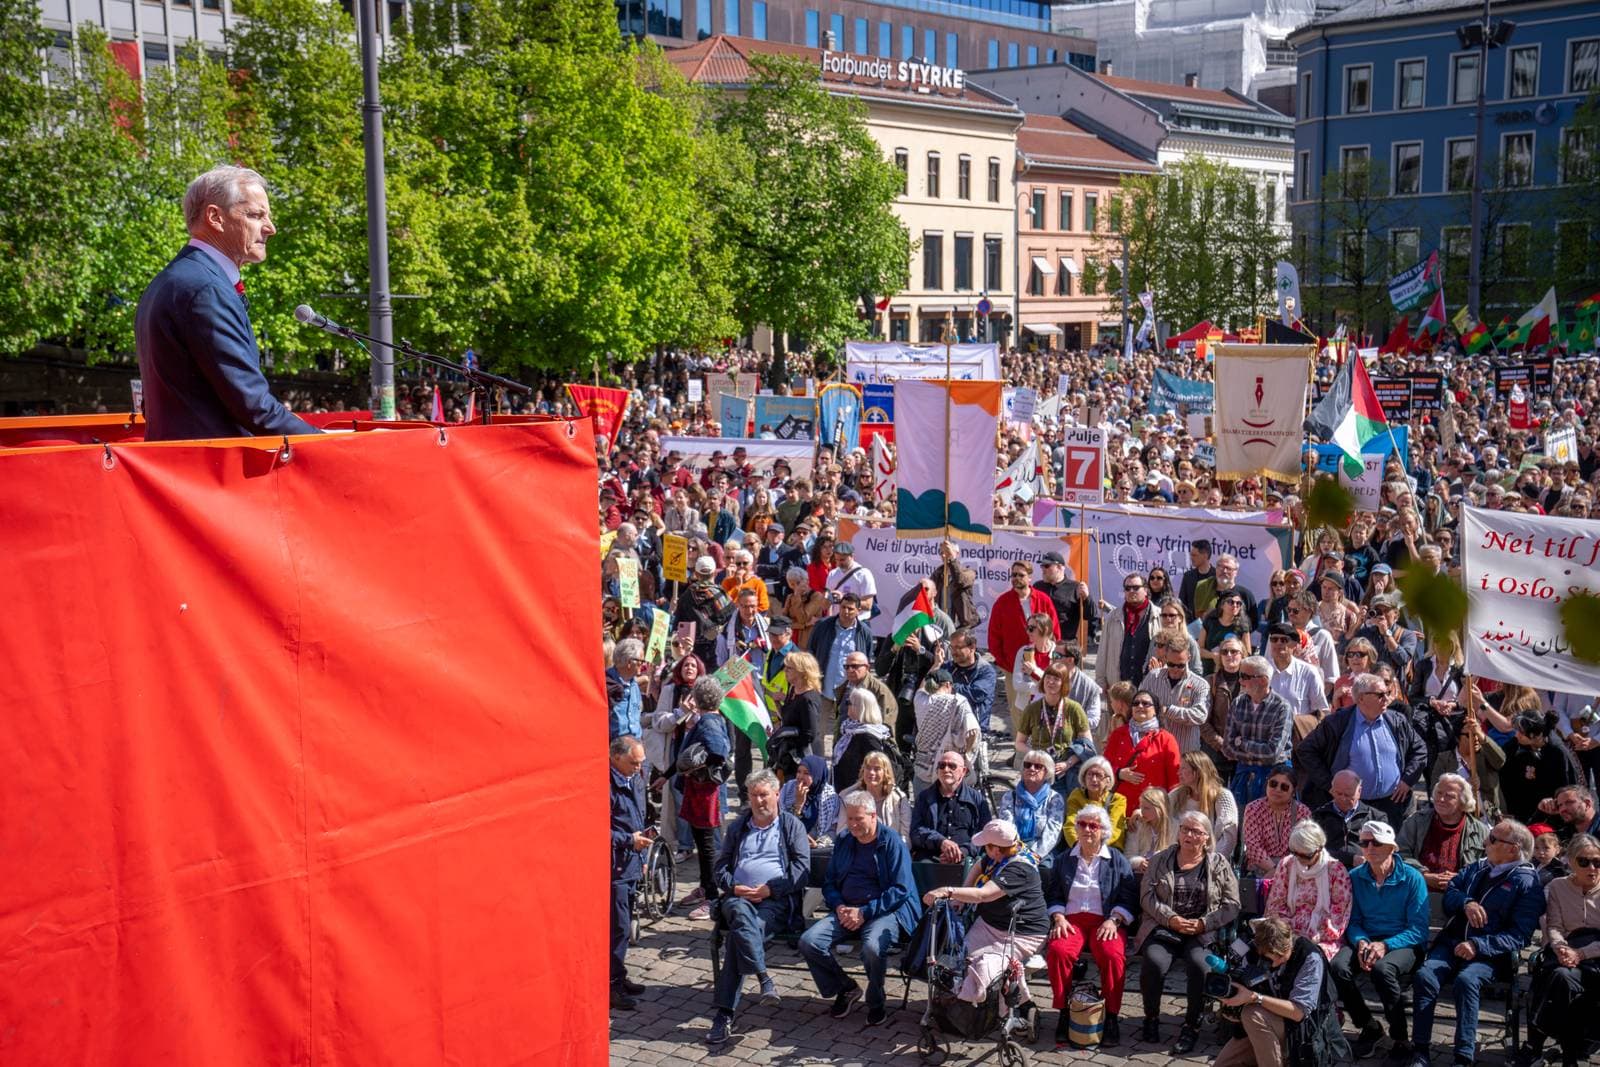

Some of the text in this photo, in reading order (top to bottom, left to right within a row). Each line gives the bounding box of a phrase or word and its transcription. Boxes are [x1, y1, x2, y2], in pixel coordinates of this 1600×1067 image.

[823, 50, 963, 89] Forbundet STYRKE
[1068, 431, 1100, 445] Pulje
[1221, 428, 1296, 437] DRAMATIKERFORBUNDET
[1070, 451, 1096, 485] 7
[866, 537, 888, 551] Nei
[891, 538, 902, 551] til
[1088, 527, 1256, 560] Kunst er ytrinfrihet
[1481, 531, 1600, 566] Nei til f
[885, 563, 900, 574] av
[904, 560, 934, 575] kultu
[1118, 555, 1149, 573] frihet
[1481, 573, 1490, 591] i
[1499, 576, 1562, 603] Oslo,
